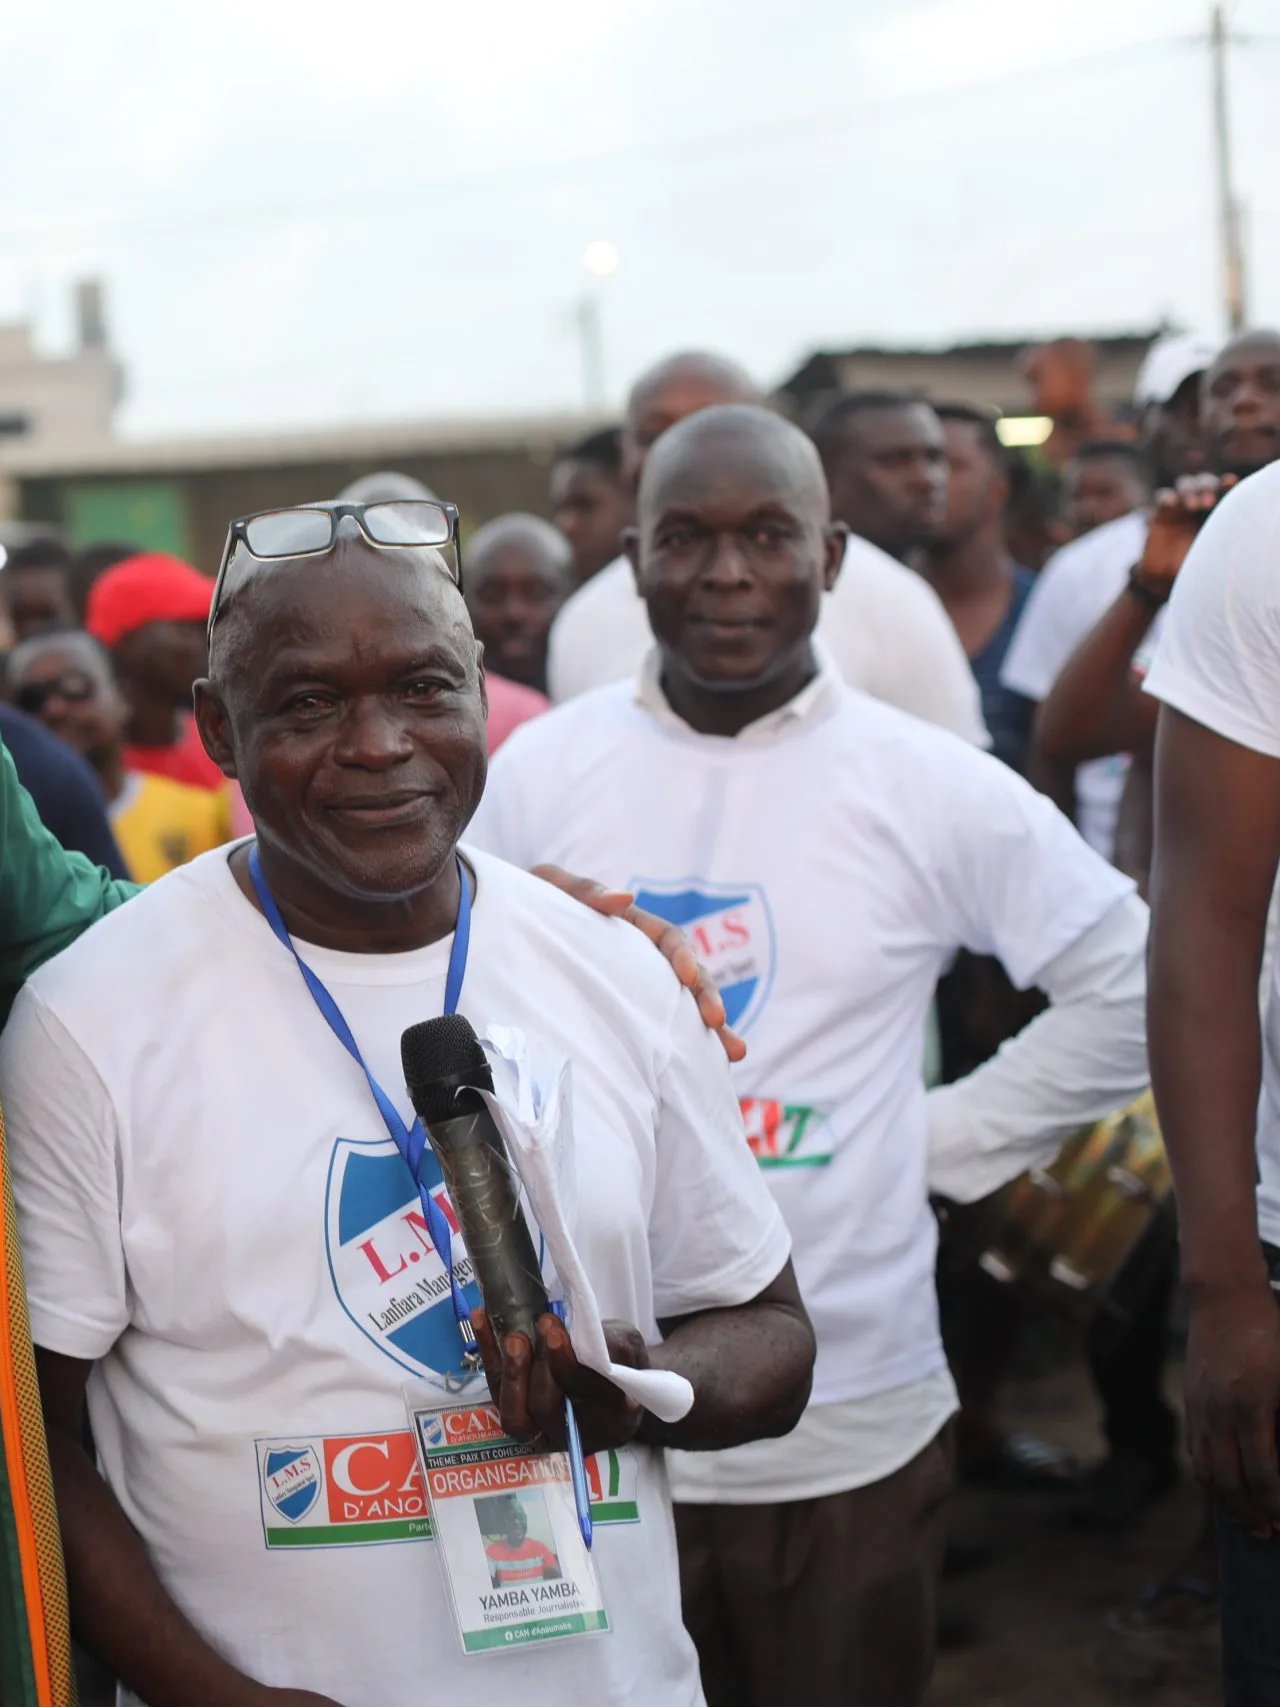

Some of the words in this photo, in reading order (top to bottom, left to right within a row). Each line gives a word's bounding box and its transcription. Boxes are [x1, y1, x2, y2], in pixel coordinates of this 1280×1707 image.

[367, 1290, 425, 1332] Lanfiara
[446, 1407, 503, 1435] CAN
[427, 1456, 460, 1469] THEME:
[460, 1452, 479, 1464] PAIX
[480, 1450, 491, 1462] ET
[478, 1589, 529, 1611] YAMBA
[530, 1581, 581, 1601] YAMBA
[483, 1607, 536, 1624] Responsable
[514, 1628, 530, 1639] CAN
[530, 1622, 573, 1637] d'Anoumabo
